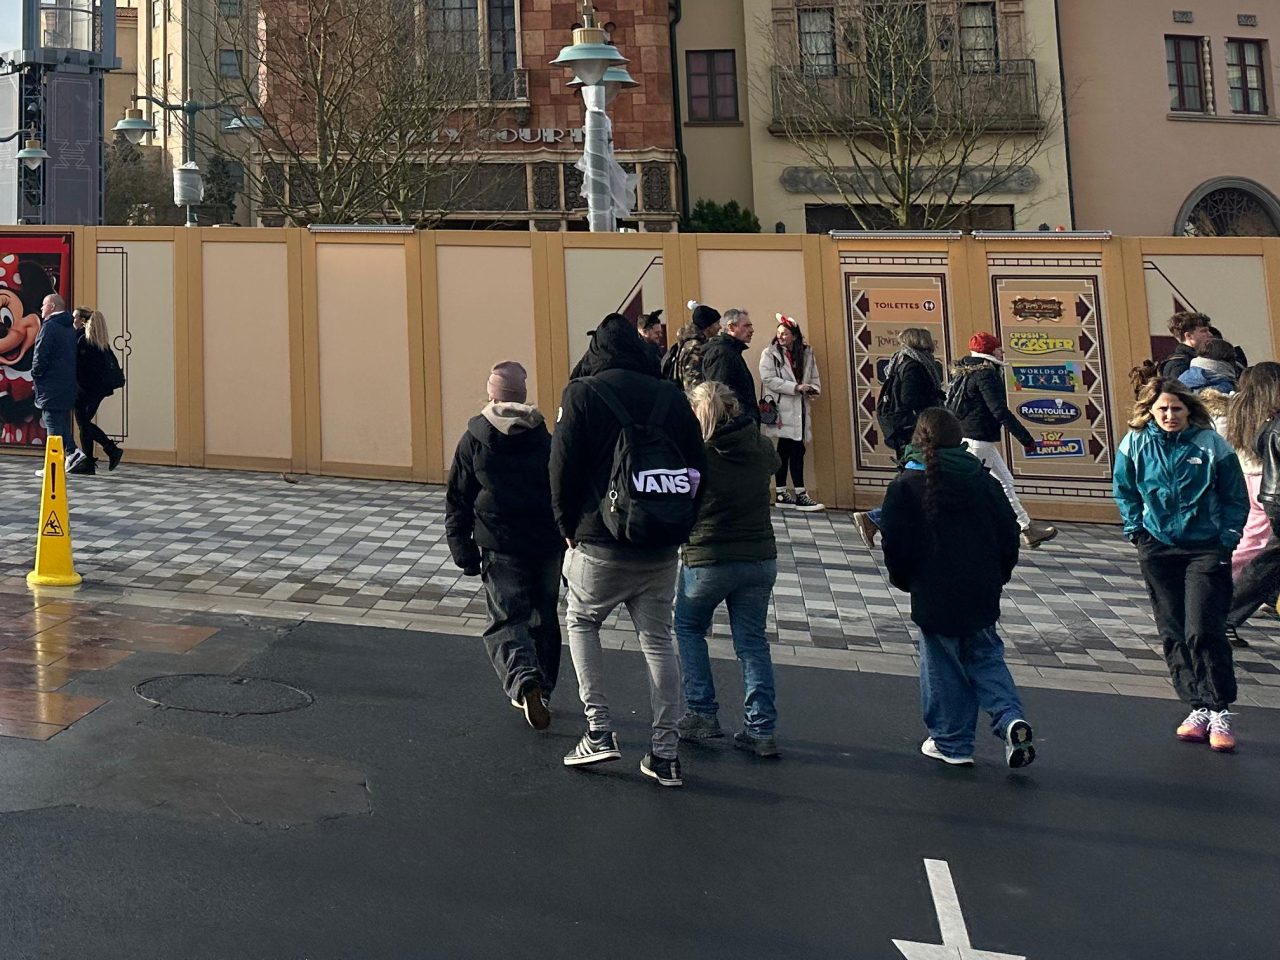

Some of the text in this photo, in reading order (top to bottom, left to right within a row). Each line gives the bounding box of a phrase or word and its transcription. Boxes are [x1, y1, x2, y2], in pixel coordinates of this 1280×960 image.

[874, 302, 920, 310] TOILETTES
[1009, 339, 1075, 351] COASTER
[1019, 374, 1074, 387] PIXAR
[1021, 406, 1077, 415] RATATOUILLE
[1041, 431, 1062, 441] TOY
[1032, 443, 1079, 454] LAYLAND
[632, 468, 691, 494] VANS
